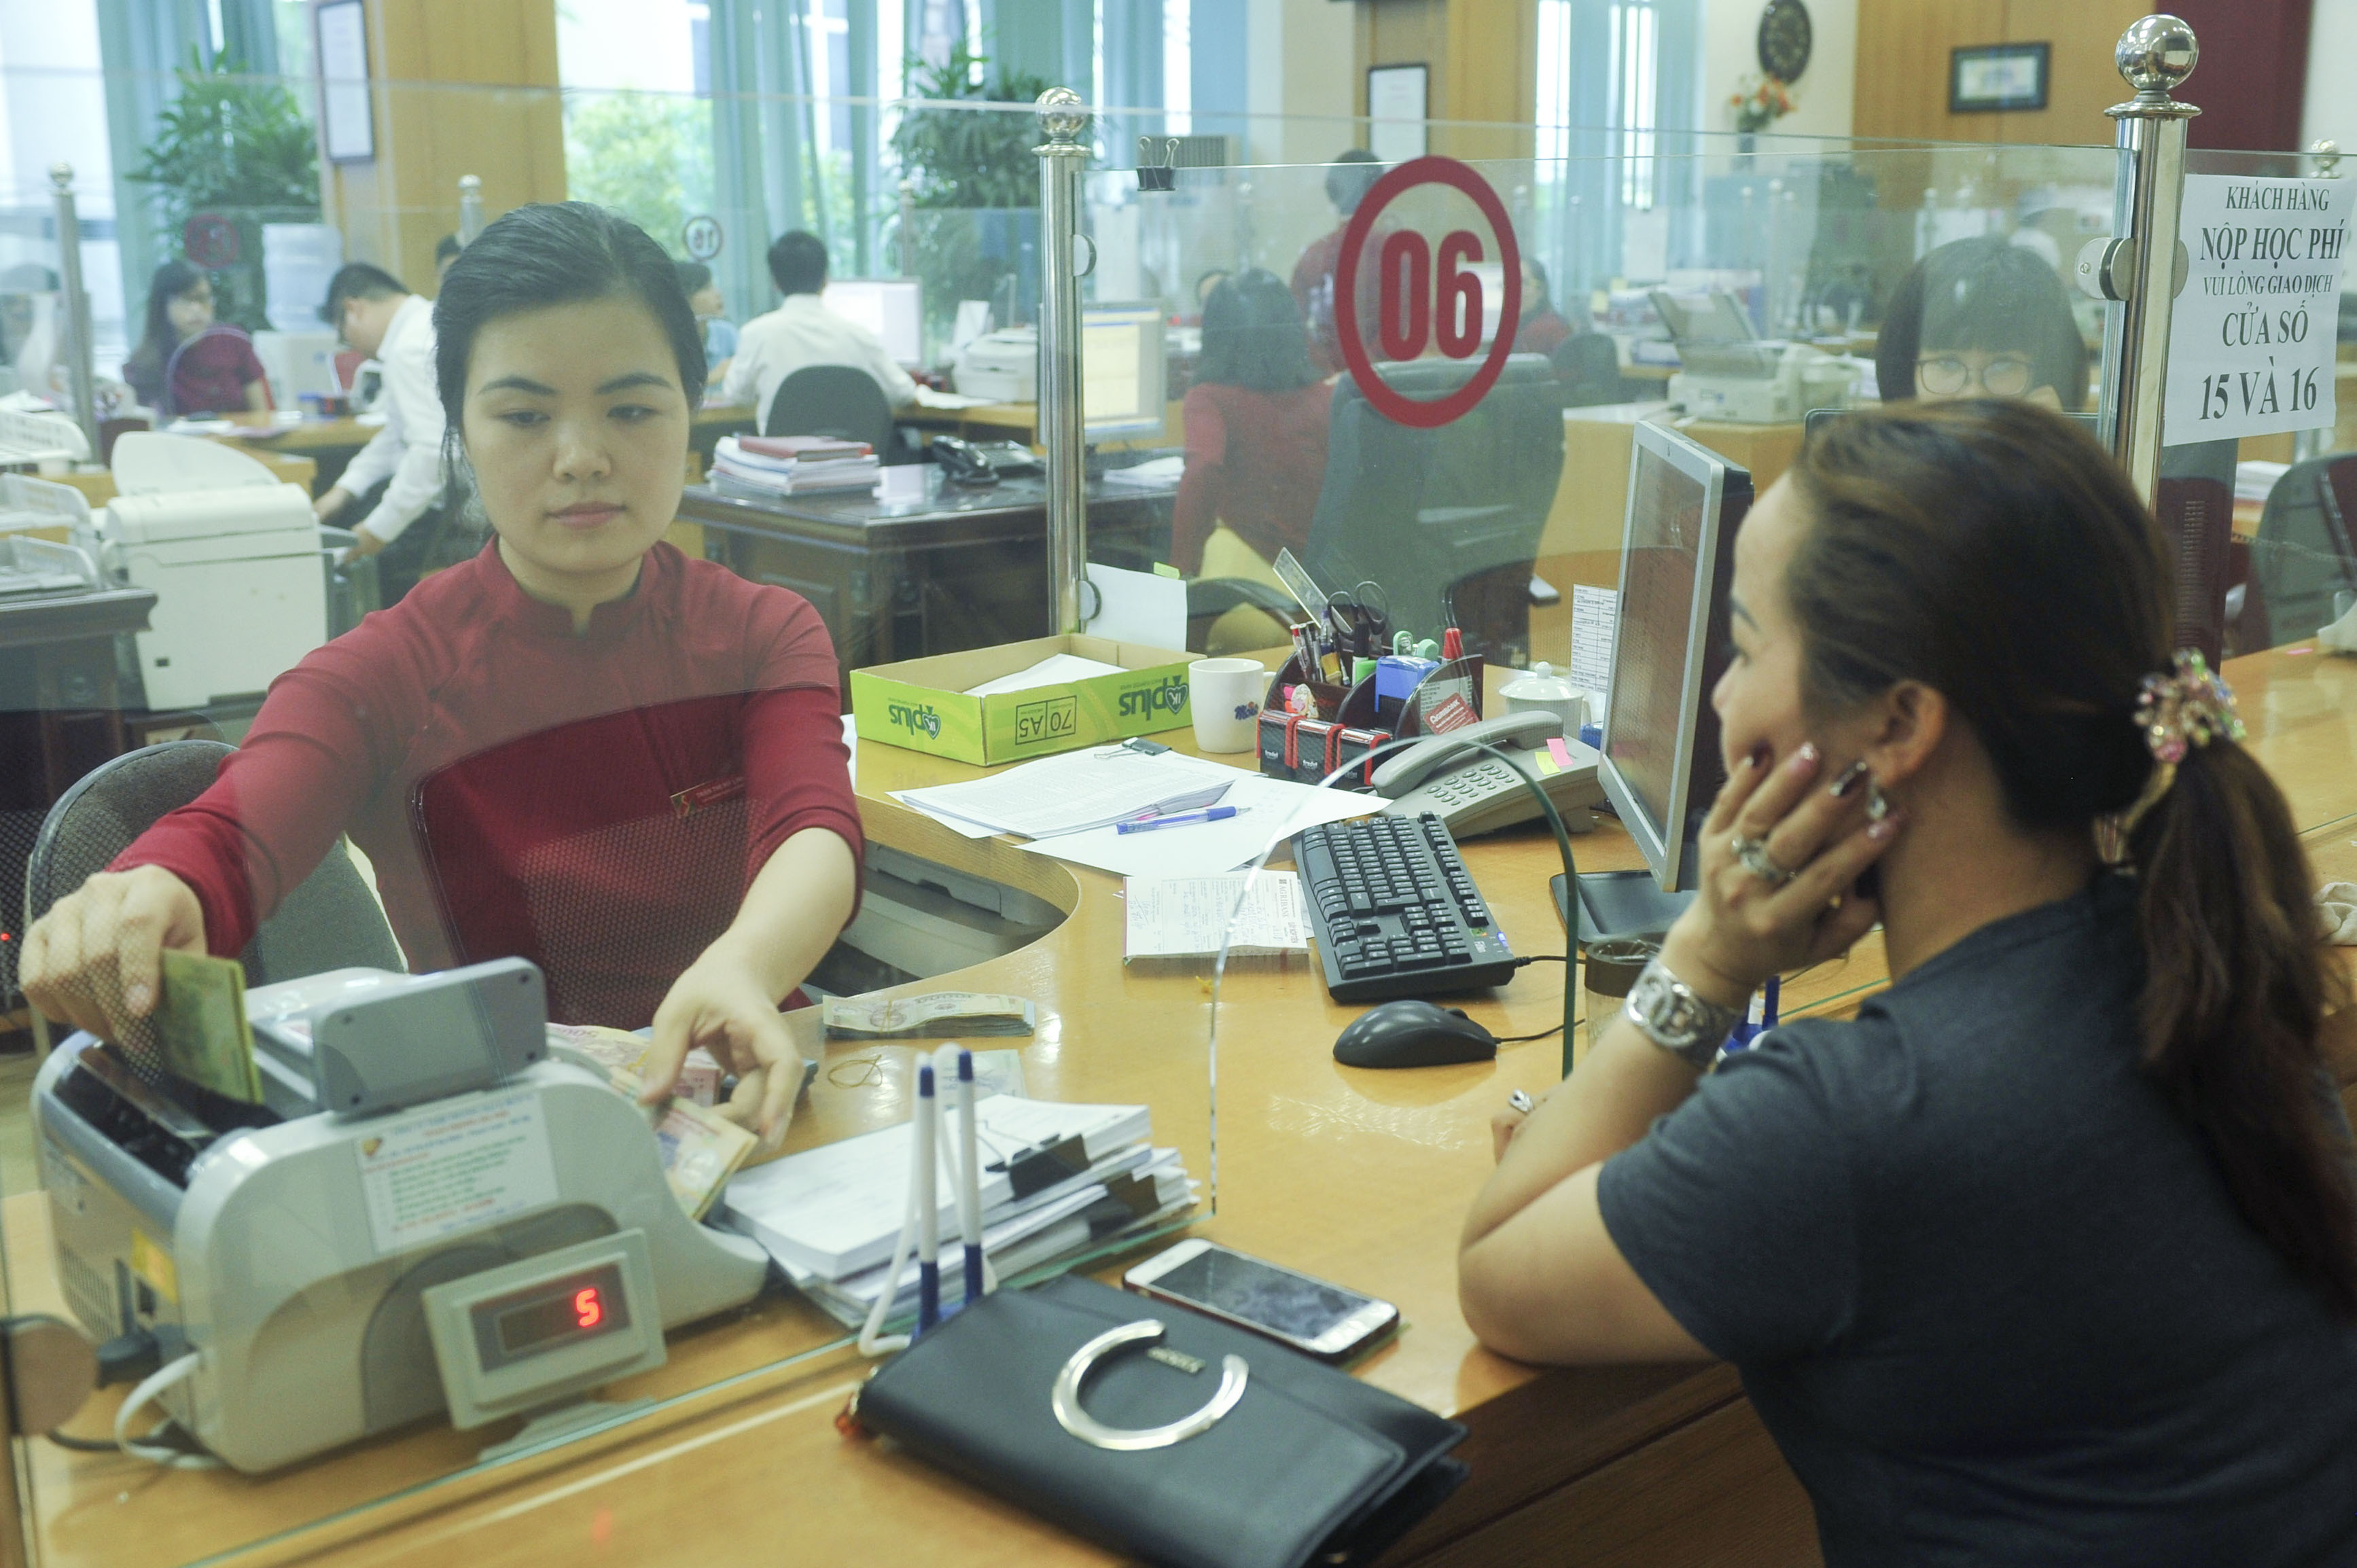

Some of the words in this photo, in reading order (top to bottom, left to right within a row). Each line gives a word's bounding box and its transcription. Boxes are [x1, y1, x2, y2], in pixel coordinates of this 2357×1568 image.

[2225, 180, 2284, 211] KHÁCH
[2286, 181, 2330, 212] HÀNG
[2199, 222, 2248, 270] NỘP
[2250, 227, 2303, 270] HỌC
[2307, 219, 2345, 260] PHÍ
[1379, 229, 1484, 362] 06
[2203, 277, 2225, 297] VUI
[2228, 270, 2265, 296] LÒNG
[2267, 274, 2303, 295] GIAO
[2304, 274, 2334, 298] DỊCH
[2222, 301, 2271, 347] CỬA
[2277, 300, 2309, 344] SỐ
[2199, 373, 2231, 421] 15
[2239, 355, 2280, 416] VÀ
[2289, 366, 2320, 412] 16
[888, 703, 927, 736] plus
[1119, 677, 1169, 721] plus
[1019, 715, 1044, 738] A5
[1050, 709, 1071, 732] 70
[575, 1287, 601, 1328] 5
